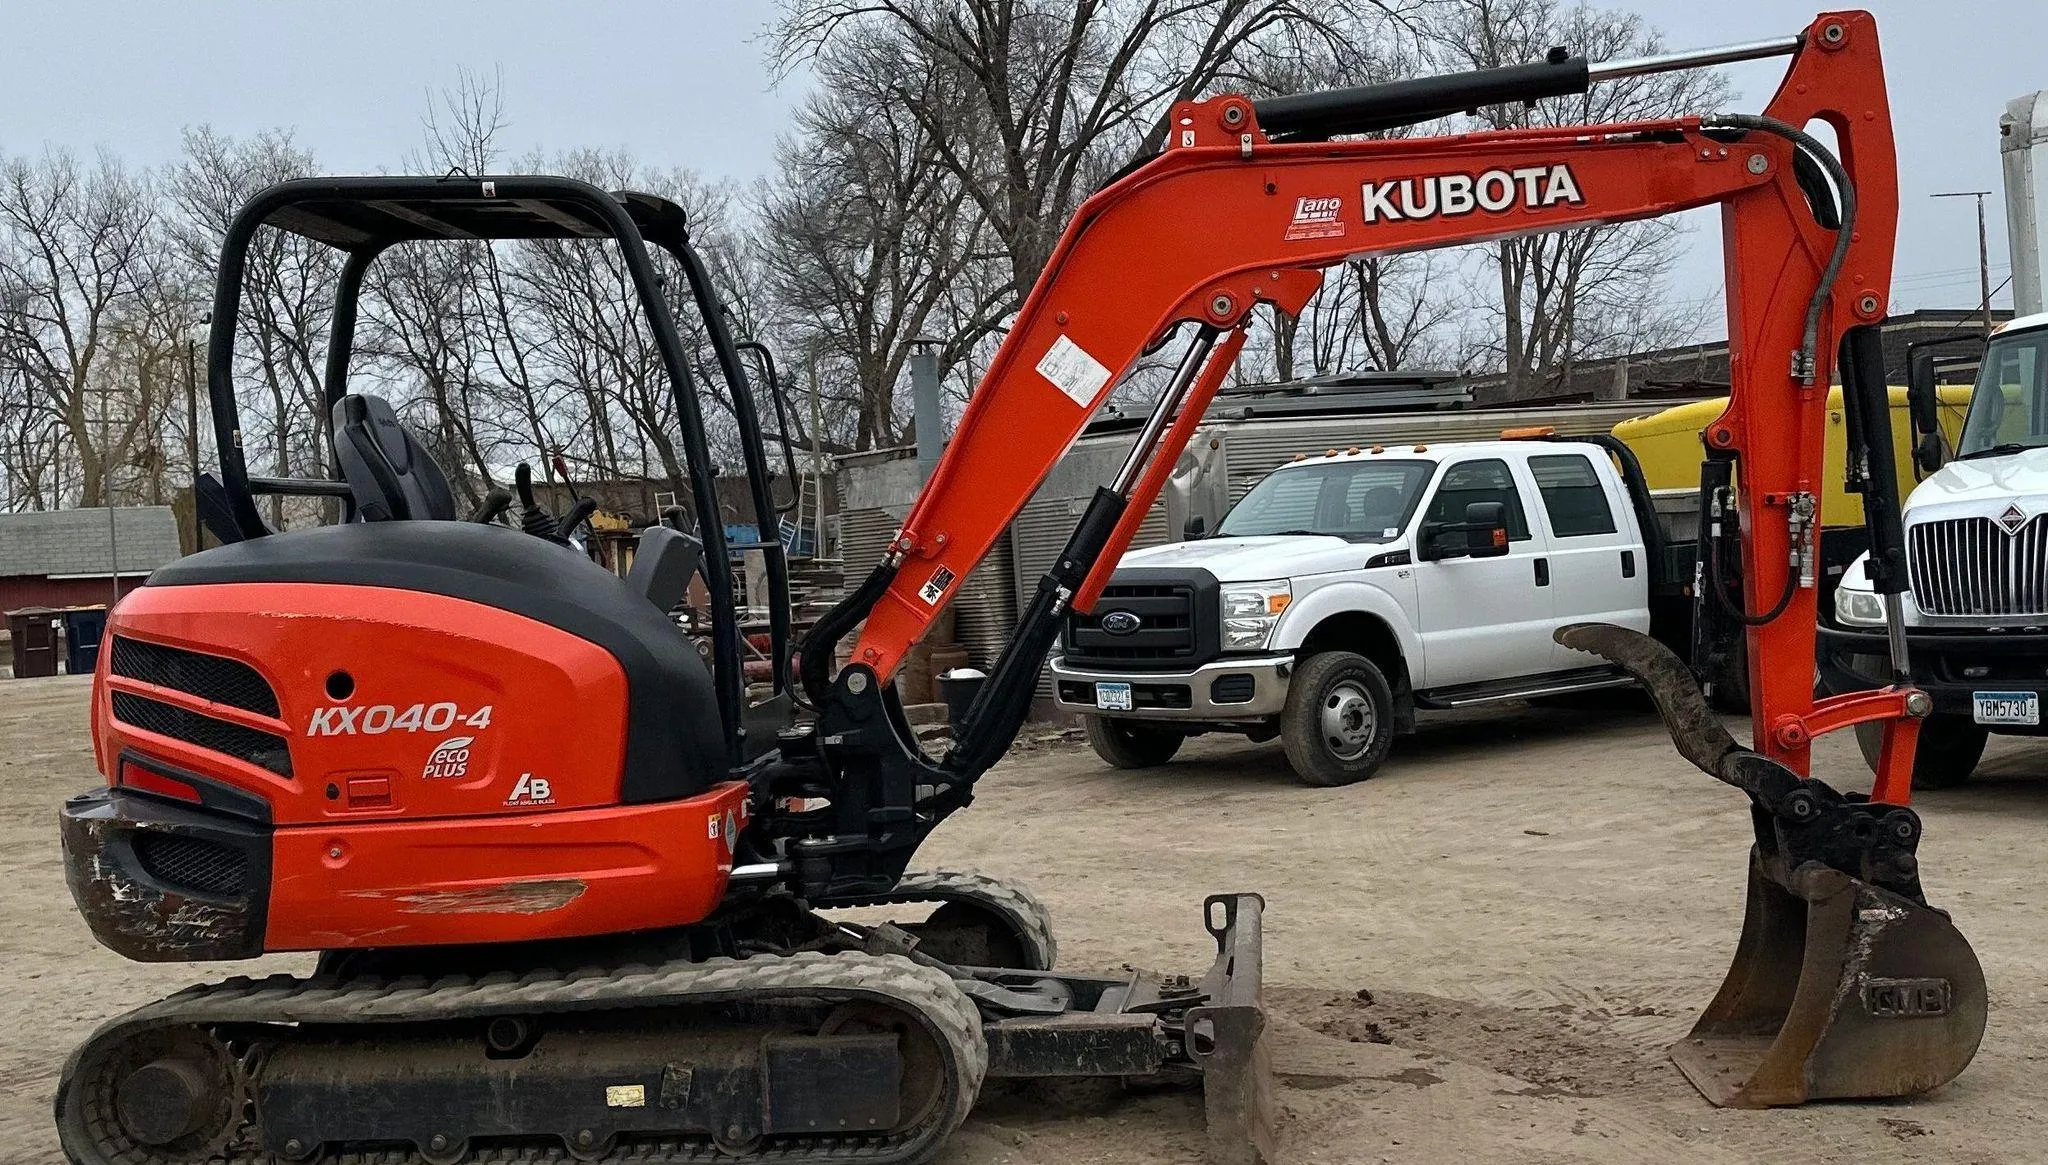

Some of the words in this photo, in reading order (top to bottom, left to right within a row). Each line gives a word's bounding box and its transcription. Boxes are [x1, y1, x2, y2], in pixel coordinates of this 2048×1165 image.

[1361, 164, 1582, 223] KUBOTA
[1294, 196, 1342, 220] Lano
[1107, 615, 1129, 629] Ford
[306, 702, 493, 737] KX040-4
[434, 749, 470, 764] eco
[422, 762, 468, 779] PLUS
